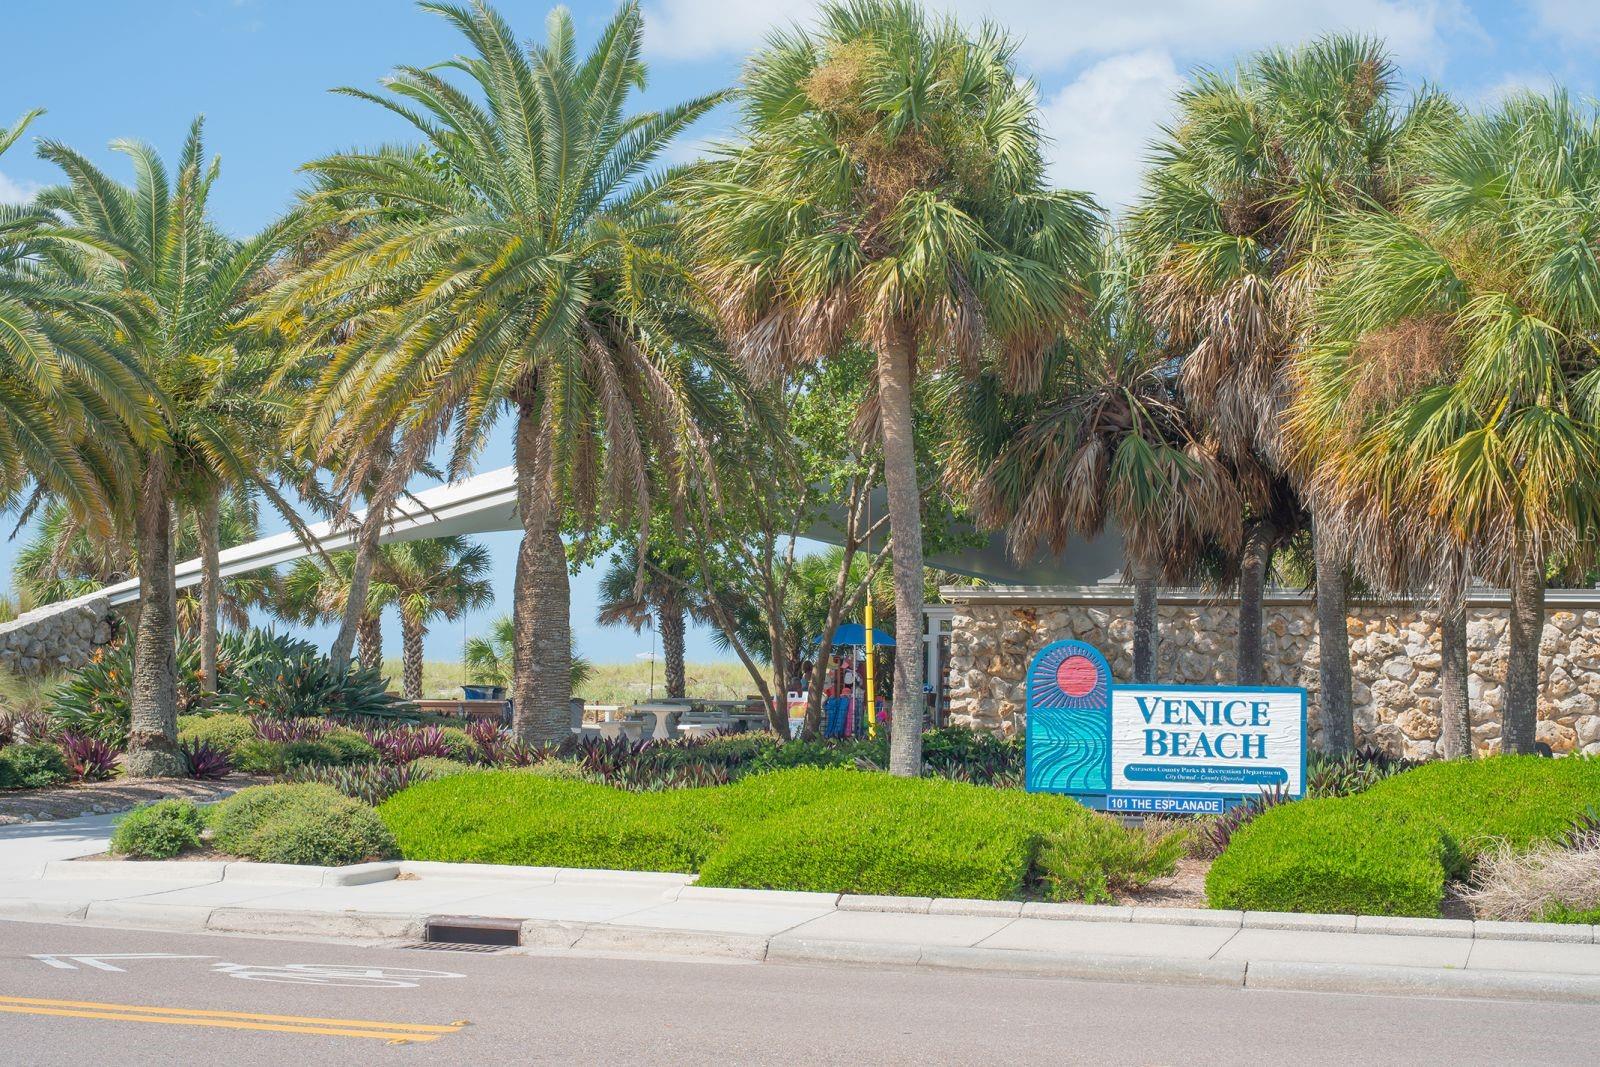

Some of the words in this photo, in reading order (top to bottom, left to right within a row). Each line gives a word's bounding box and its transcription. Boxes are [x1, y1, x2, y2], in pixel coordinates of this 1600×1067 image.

[1134, 696, 1271, 727] VENICE
[1141, 728, 1268, 759] BEACH
[1157, 767, 1181, 775] County
[1207, 767, 1242, 775] Recreation
[1243, 768, 1281, 777] Department
[1200, 774, 1220, 782] County
[1111, 798, 1129, 809] 101
[1131, 798, 1153, 810] THE
[1155, 798, 1219, 811] ESPLANADE
